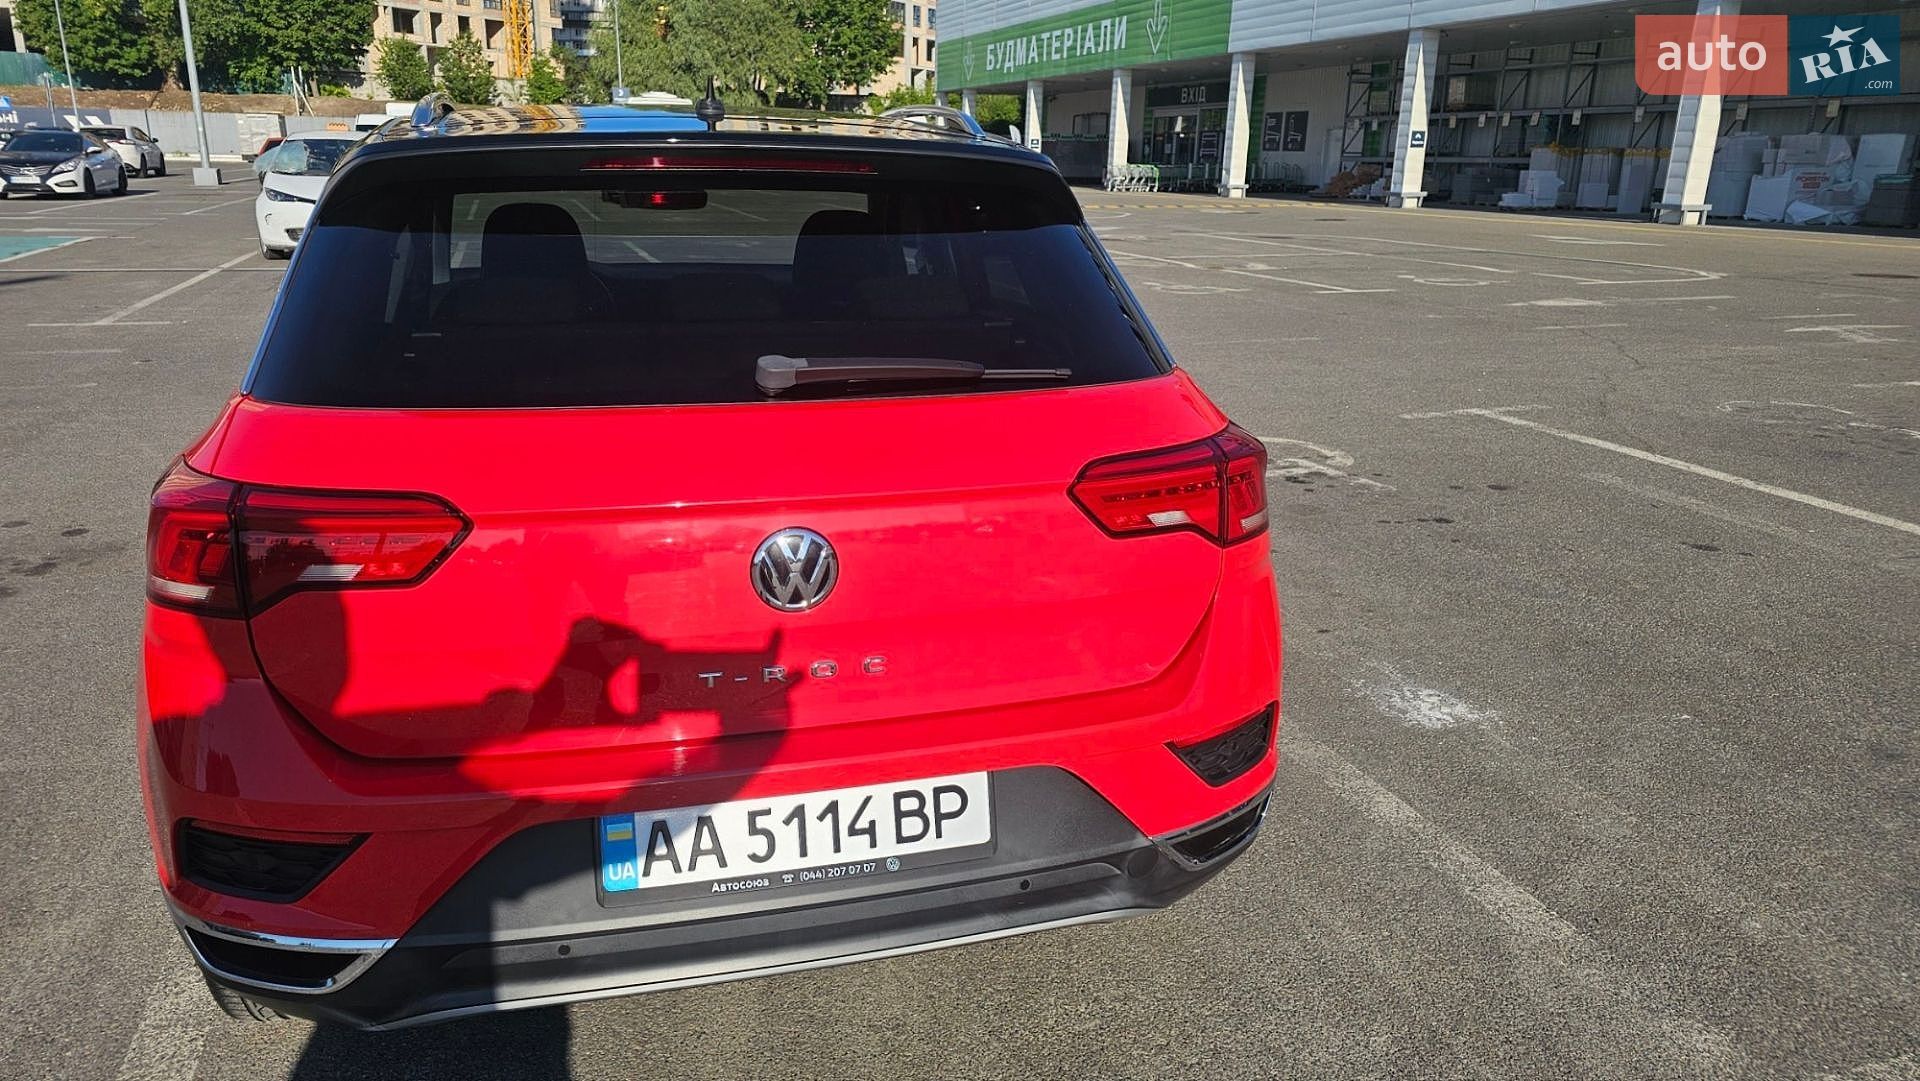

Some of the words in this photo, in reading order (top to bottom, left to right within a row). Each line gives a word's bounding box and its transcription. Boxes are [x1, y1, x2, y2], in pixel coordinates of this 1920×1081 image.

[986, 16, 1127, 73] БУДМАТЕРІАЛИ
[1181, 86, 1207, 103] ВХІД
[698, 655, 886, 688] T-ROC
[747, 795, 878, 863] 5114
[608, 861, 636, 881] UA
[799, 868, 826, 882] (044)
[827, 867, 846, 878] 207
[848, 866, 861, 875] 07
[864, 863, 876, 873] 07
